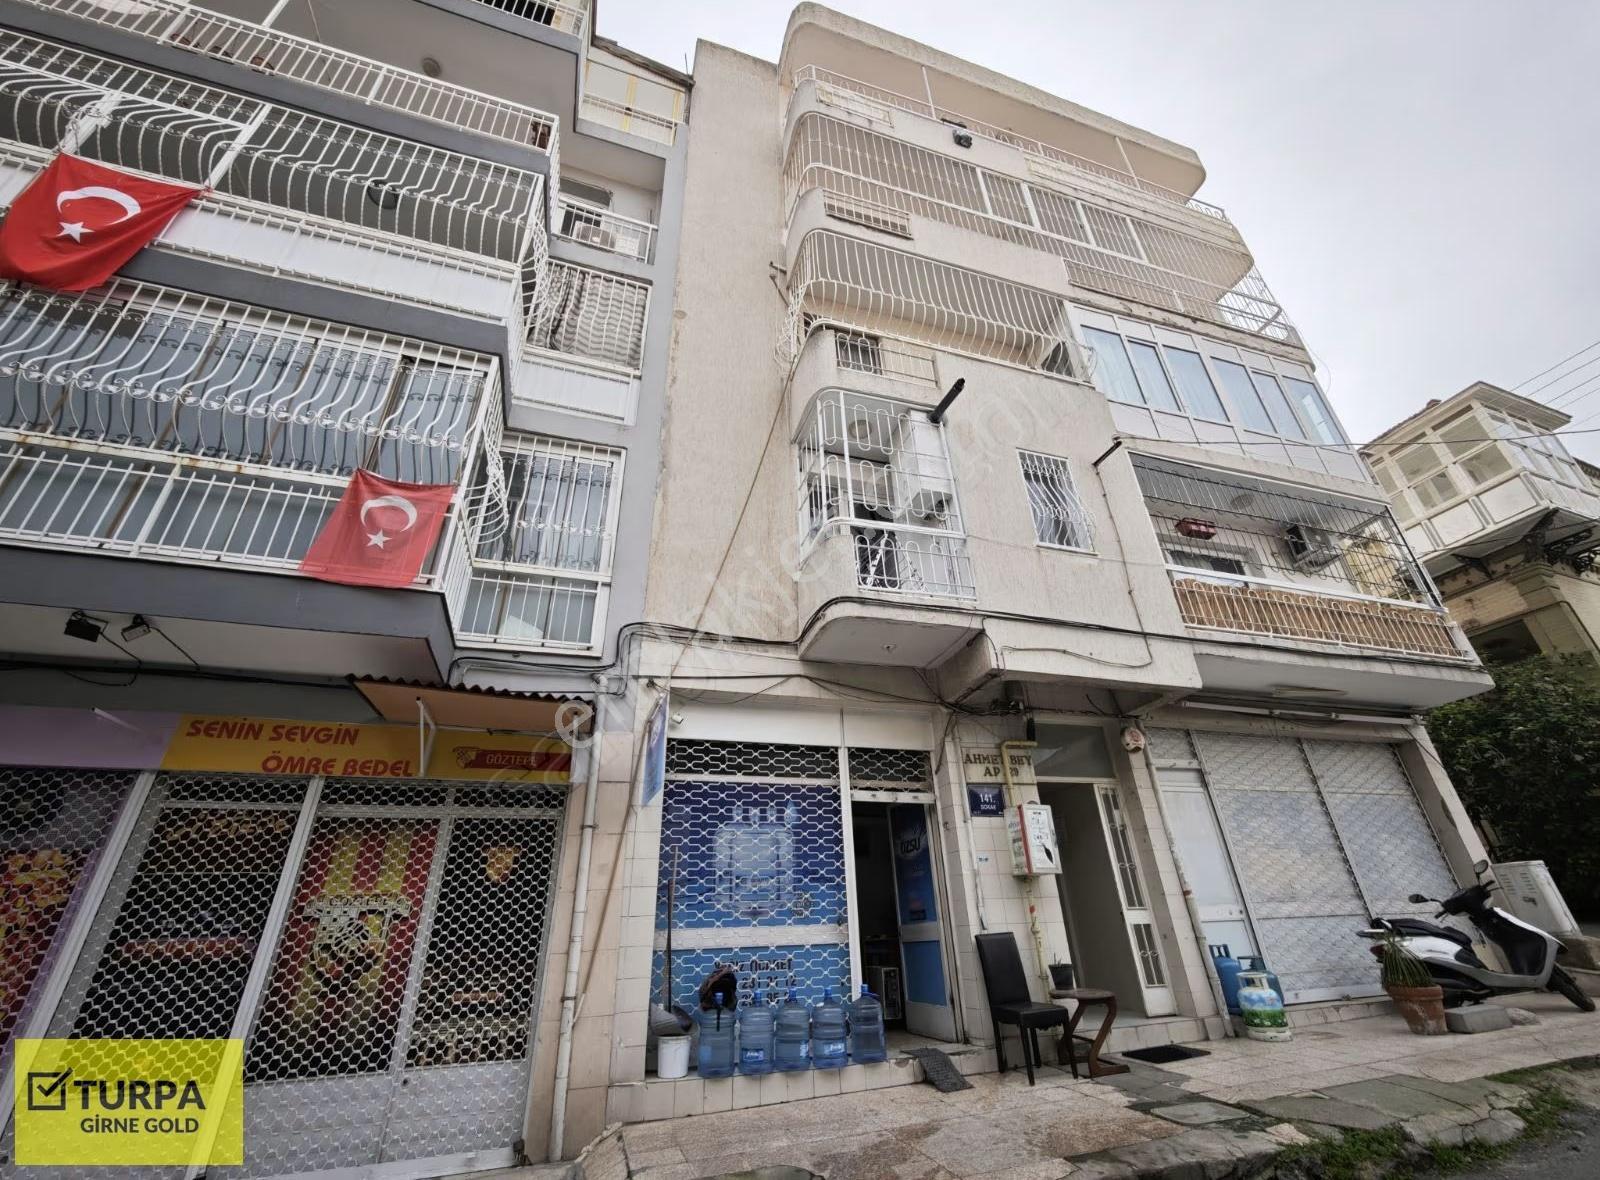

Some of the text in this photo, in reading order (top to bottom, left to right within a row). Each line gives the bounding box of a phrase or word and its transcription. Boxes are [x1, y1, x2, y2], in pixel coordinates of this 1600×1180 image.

[186, 718, 360, 746] SENİN SEVGİN
[261, 751, 413, 777] ÖMRE BEDEL
[486, 754, 537, 766] GÖZTEPE
